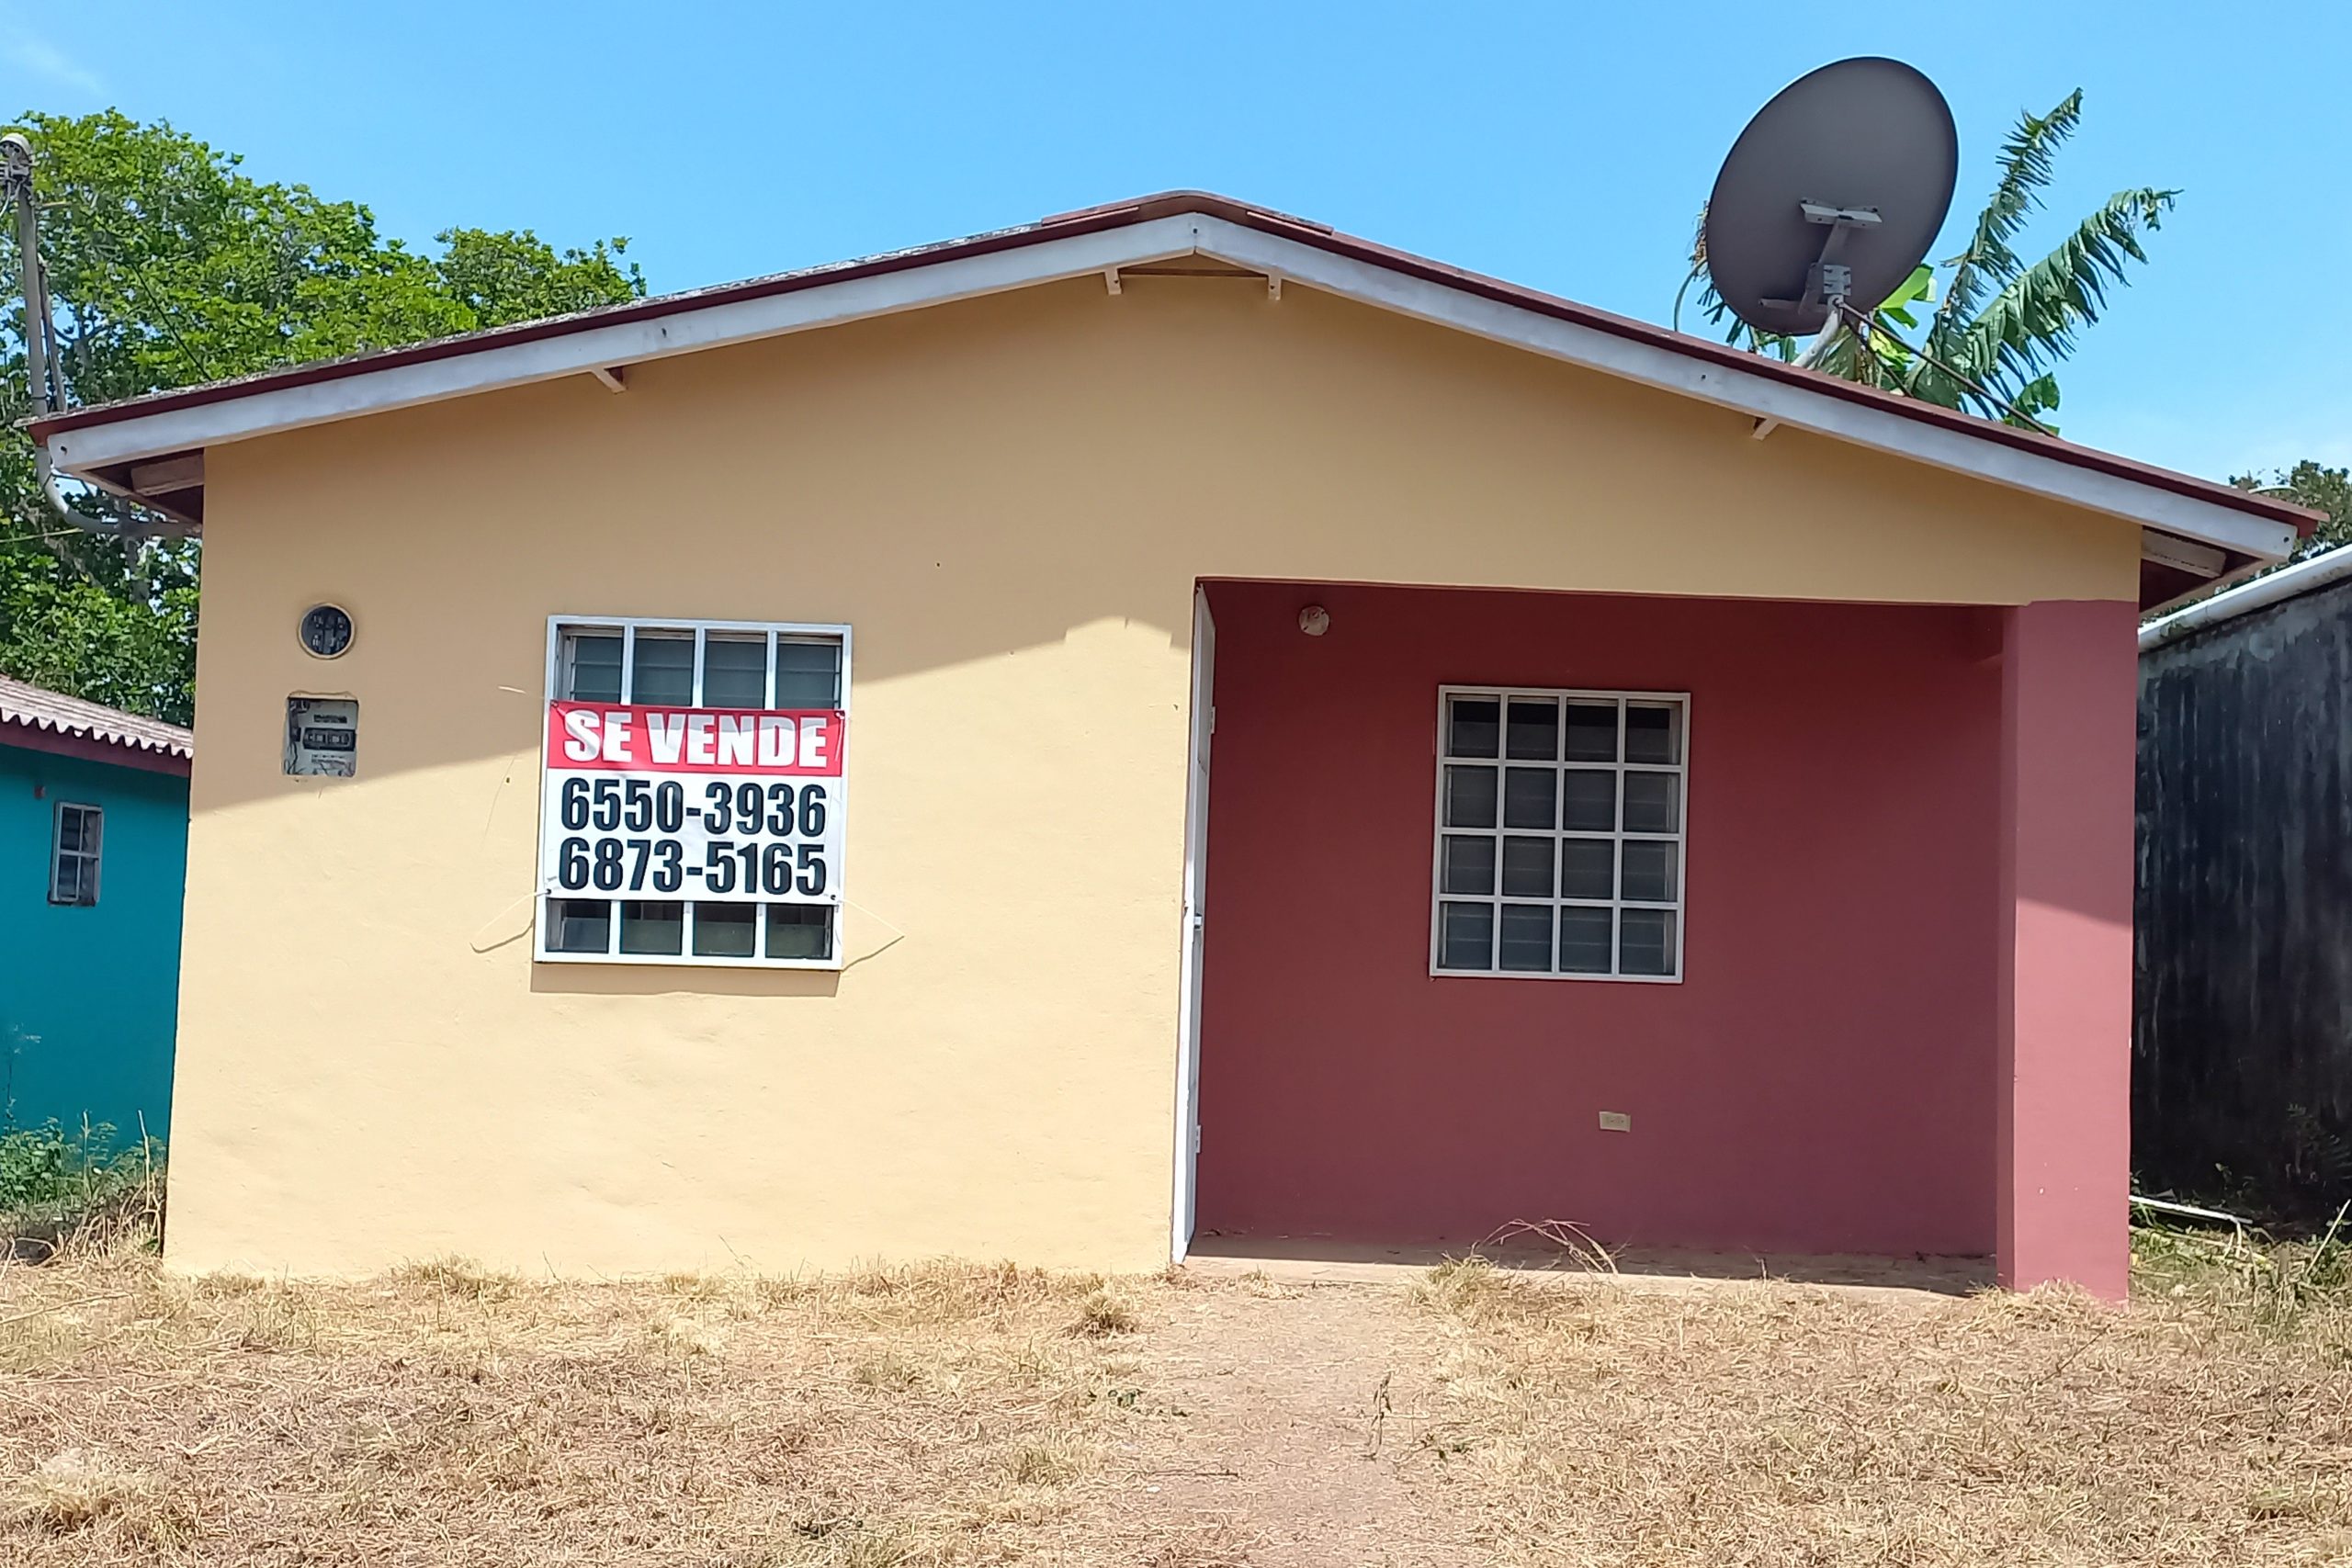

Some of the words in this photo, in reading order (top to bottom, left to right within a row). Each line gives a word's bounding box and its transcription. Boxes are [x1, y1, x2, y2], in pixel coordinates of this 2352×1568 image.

[563, 710, 632, 762] SE
[646, 712, 827, 768] VENDE
[561, 778, 826, 837] 6550-3936
[559, 837, 826, 896] 6873-5165
